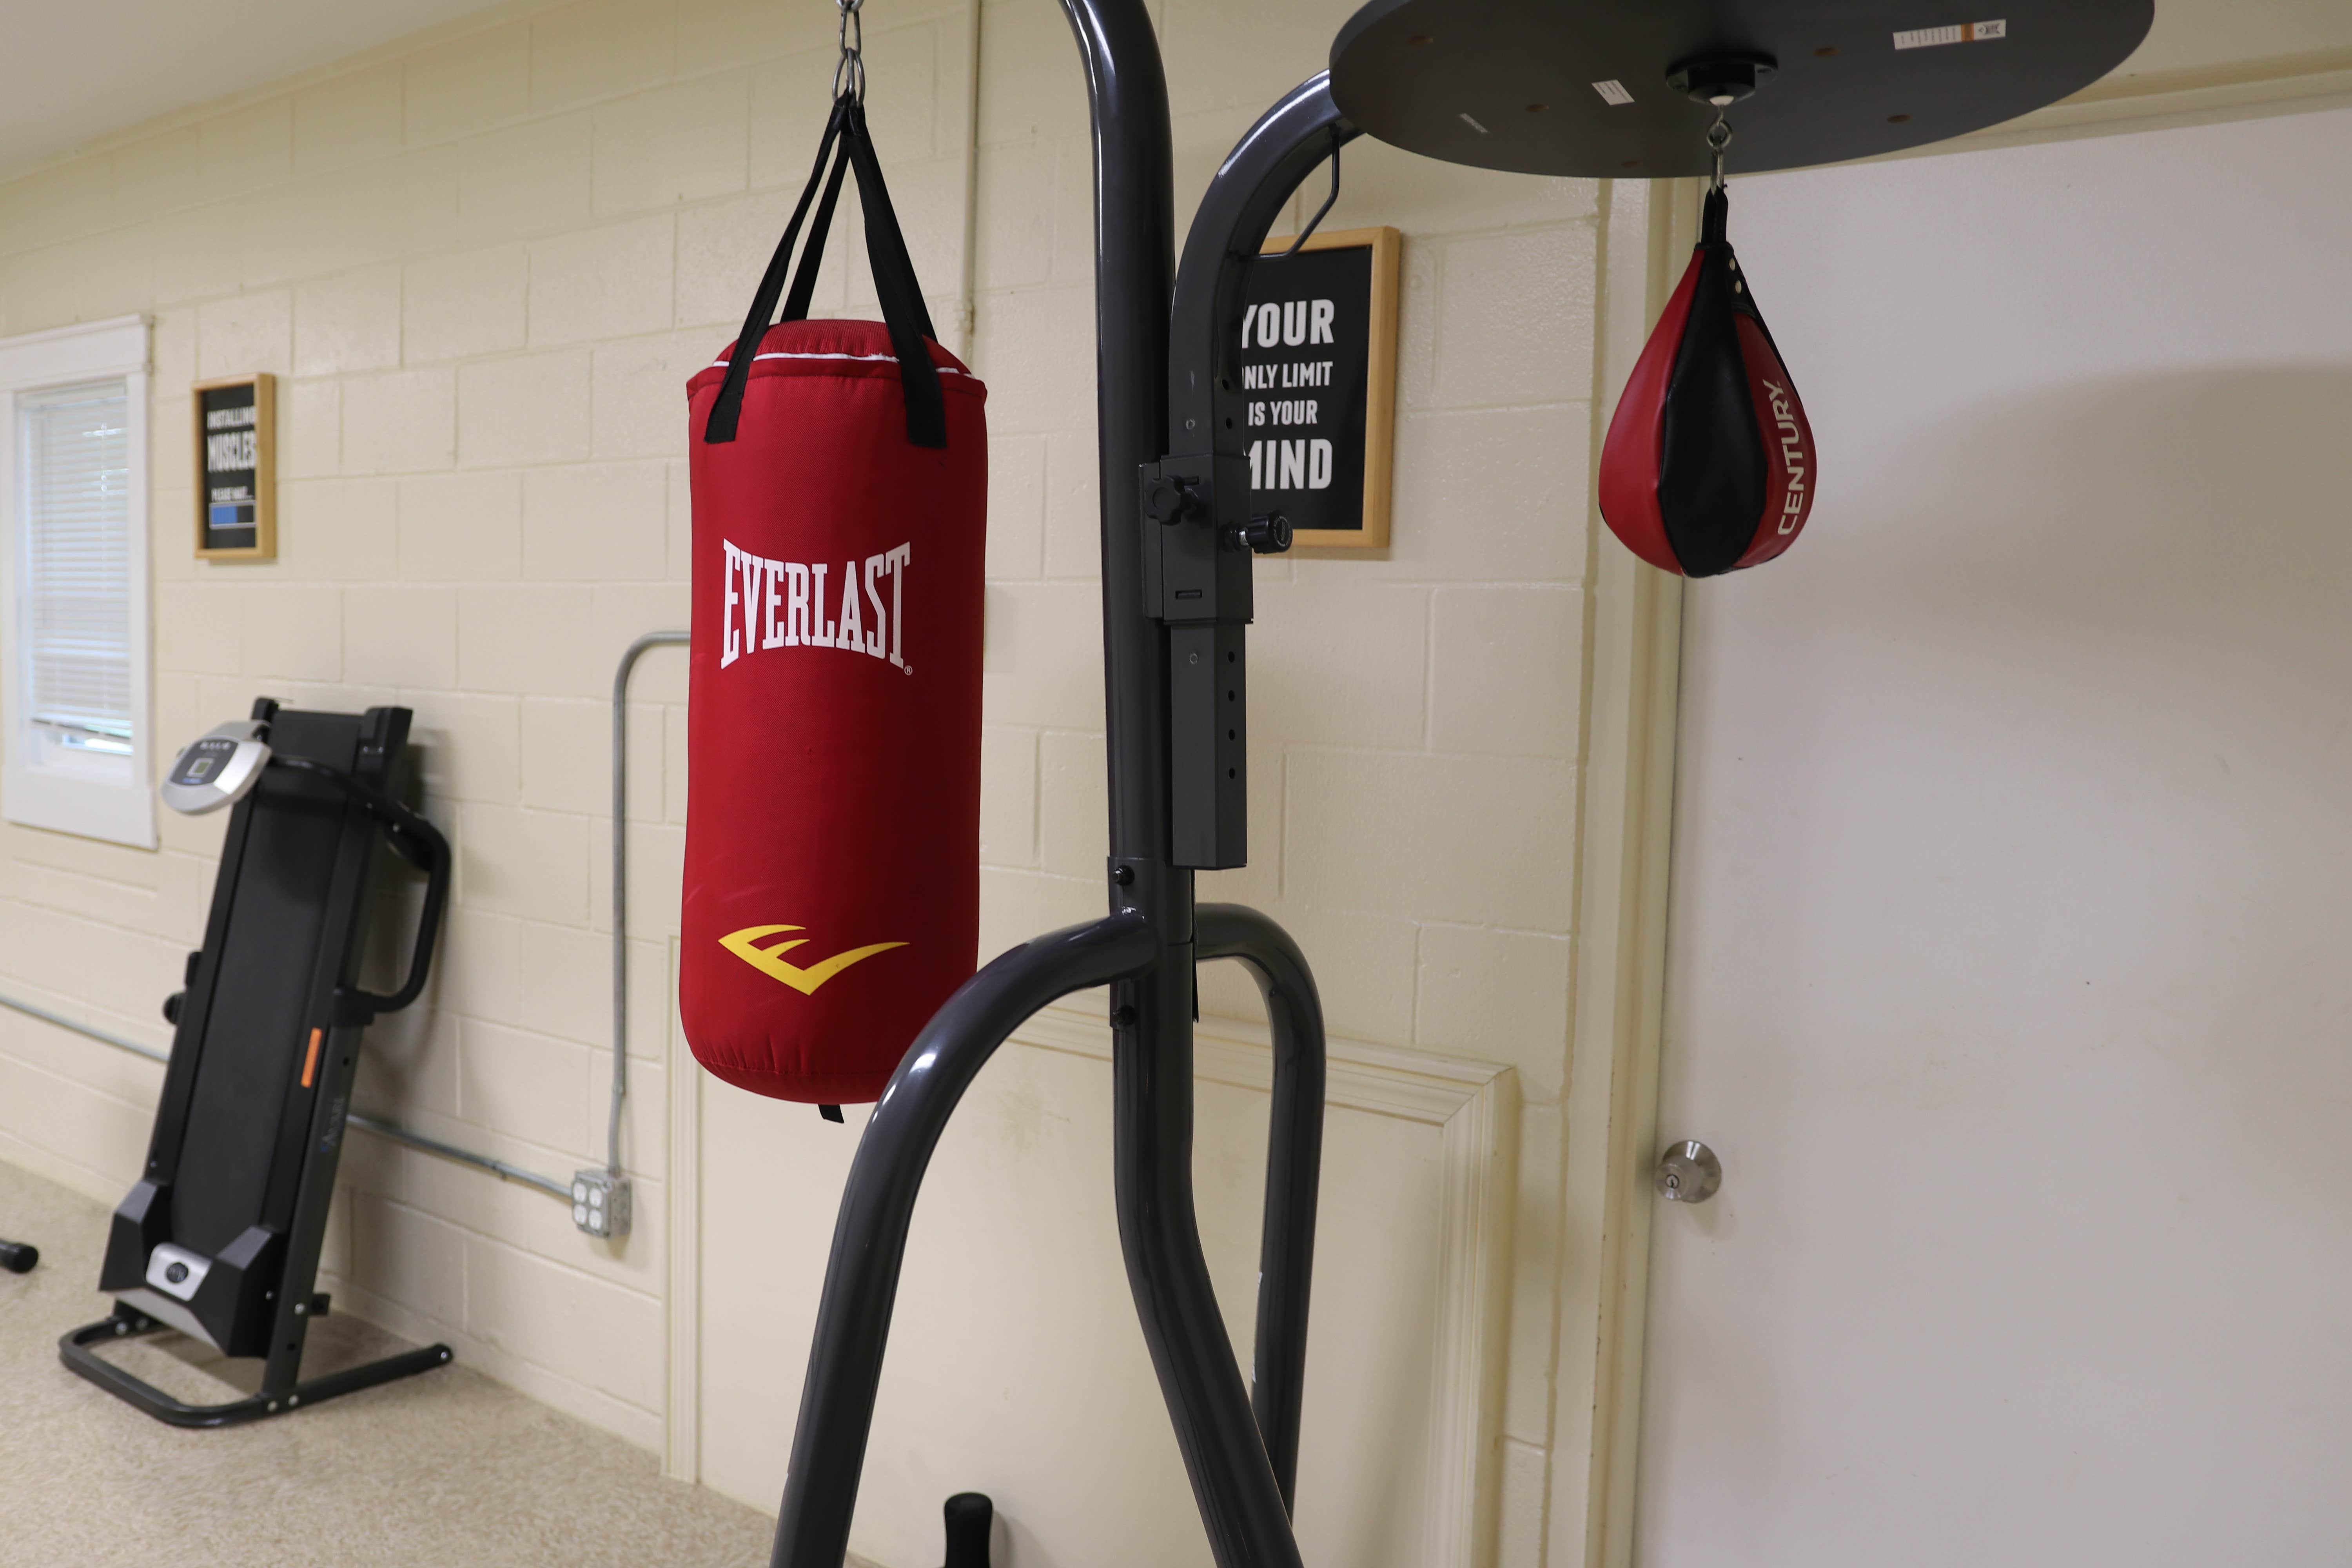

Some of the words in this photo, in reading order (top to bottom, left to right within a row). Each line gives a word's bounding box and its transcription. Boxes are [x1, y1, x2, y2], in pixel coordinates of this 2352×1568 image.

[1242, 364, 1278, 390] NLY
[1282, 361, 1333, 388] LIMIT
[207, 406, 256, 430] INSTALLING
[1248, 401, 1266, 426] IS
[1270, 399, 1318, 425] YOUR
[207, 430, 256, 472] MUSCLES
[1762, 378, 1804, 535] CENTURY
[721, 538, 910, 670] EVERLAST
